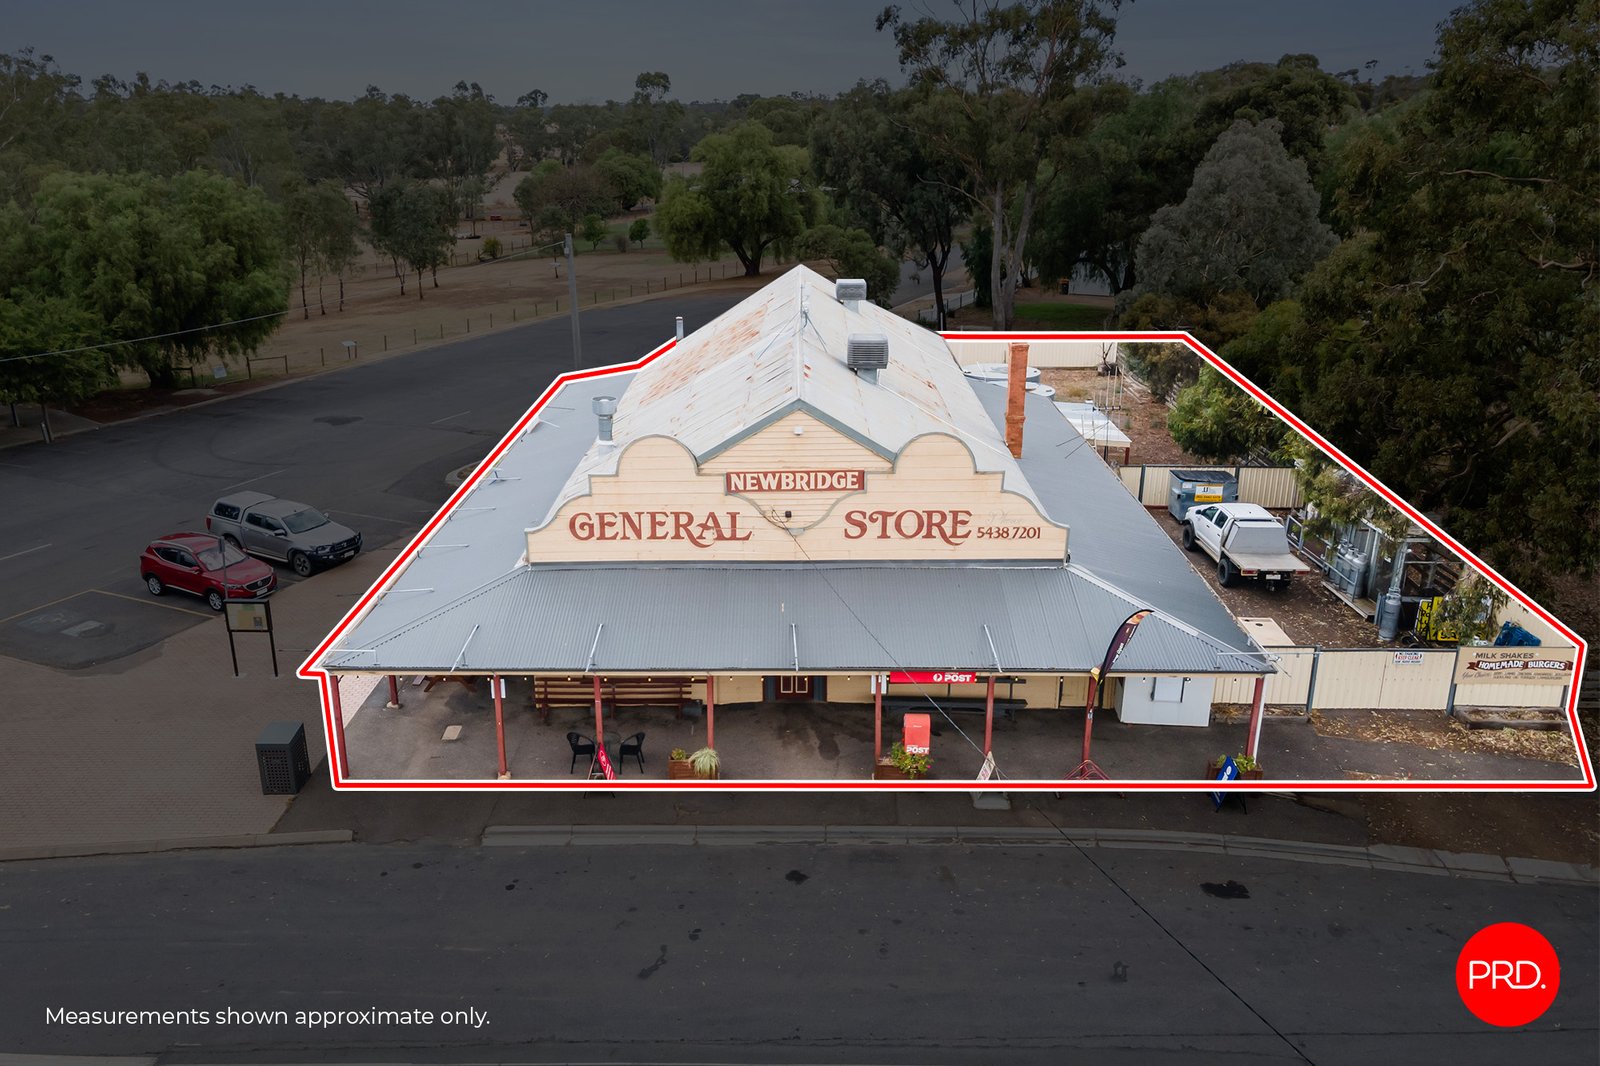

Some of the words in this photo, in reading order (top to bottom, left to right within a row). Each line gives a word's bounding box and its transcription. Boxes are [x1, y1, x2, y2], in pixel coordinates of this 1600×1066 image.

[730, 471, 859, 491] NEWBRIDGE
[568, 511, 752, 548] GENERAL
[844, 509, 973, 546] STORE
[977, 526, 1010, 539] 5438
[1011, 526, 1041, 539] 7201
[1478, 660, 1524, 670] HOMEMADE
[1527, 660, 1566, 670] BURGERS
[944, 674, 972, 682] POST
